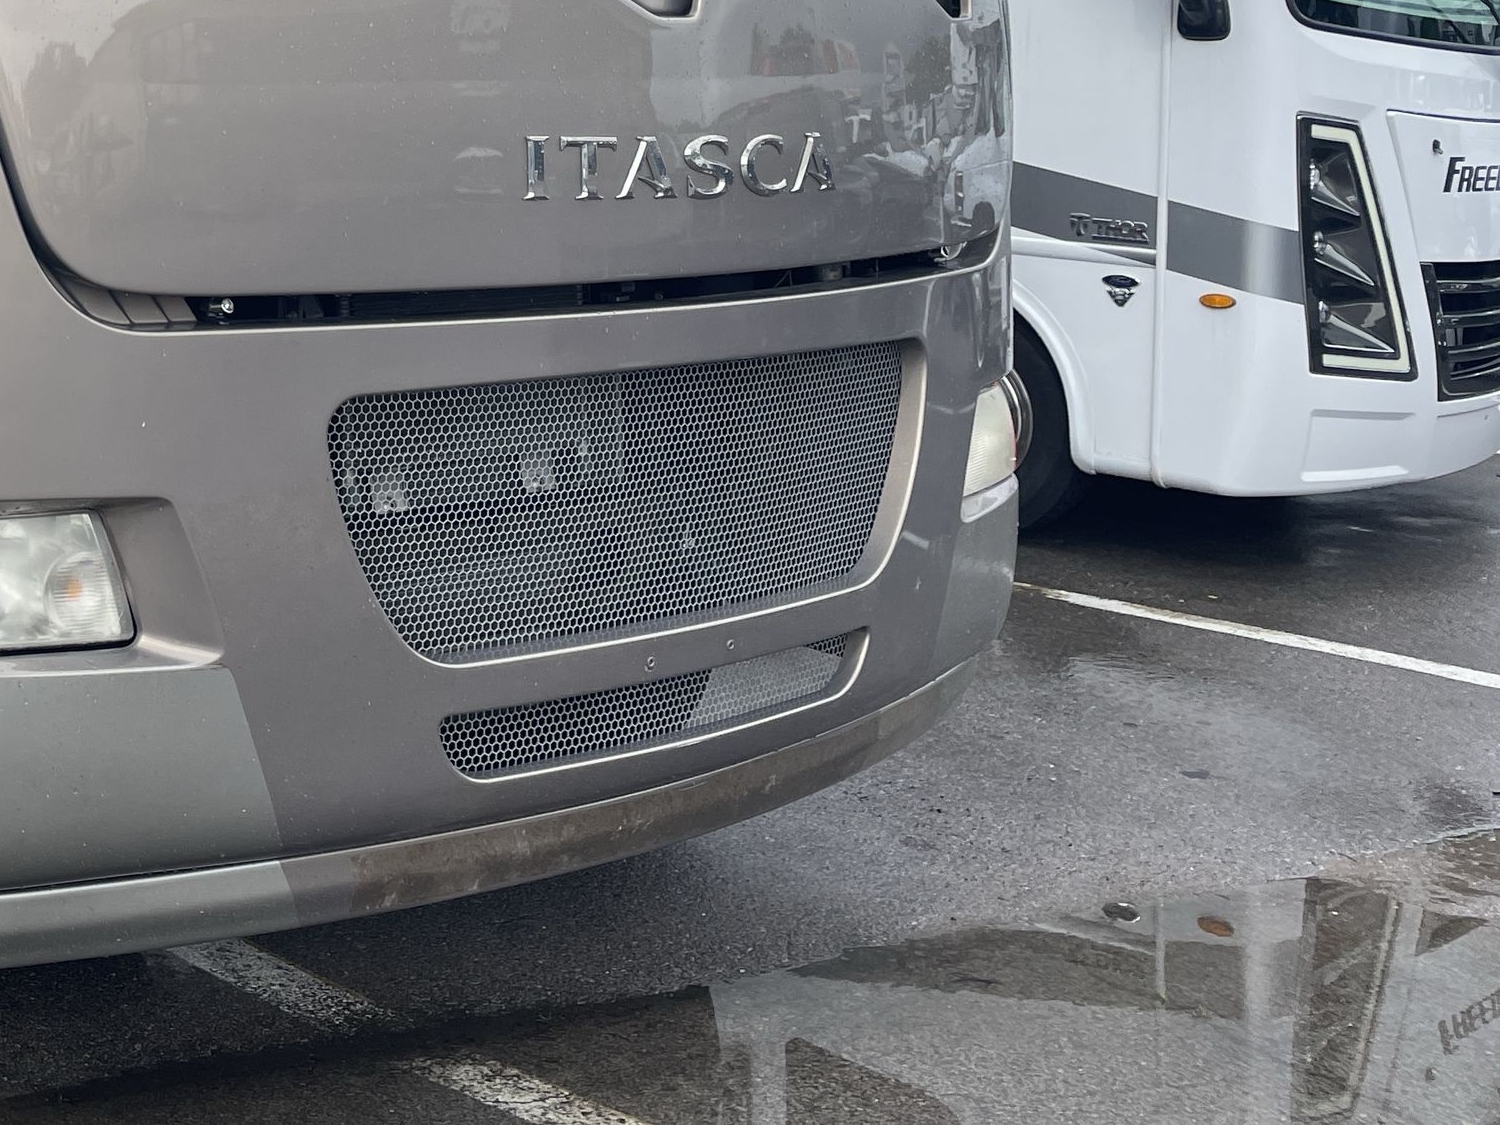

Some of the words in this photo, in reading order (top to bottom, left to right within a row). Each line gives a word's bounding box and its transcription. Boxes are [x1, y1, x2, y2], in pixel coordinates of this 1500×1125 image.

[523, 131, 837, 200] ITASCA
[1443, 156, 1500, 192] FREE
[1091, 217, 1150, 243] THOR
